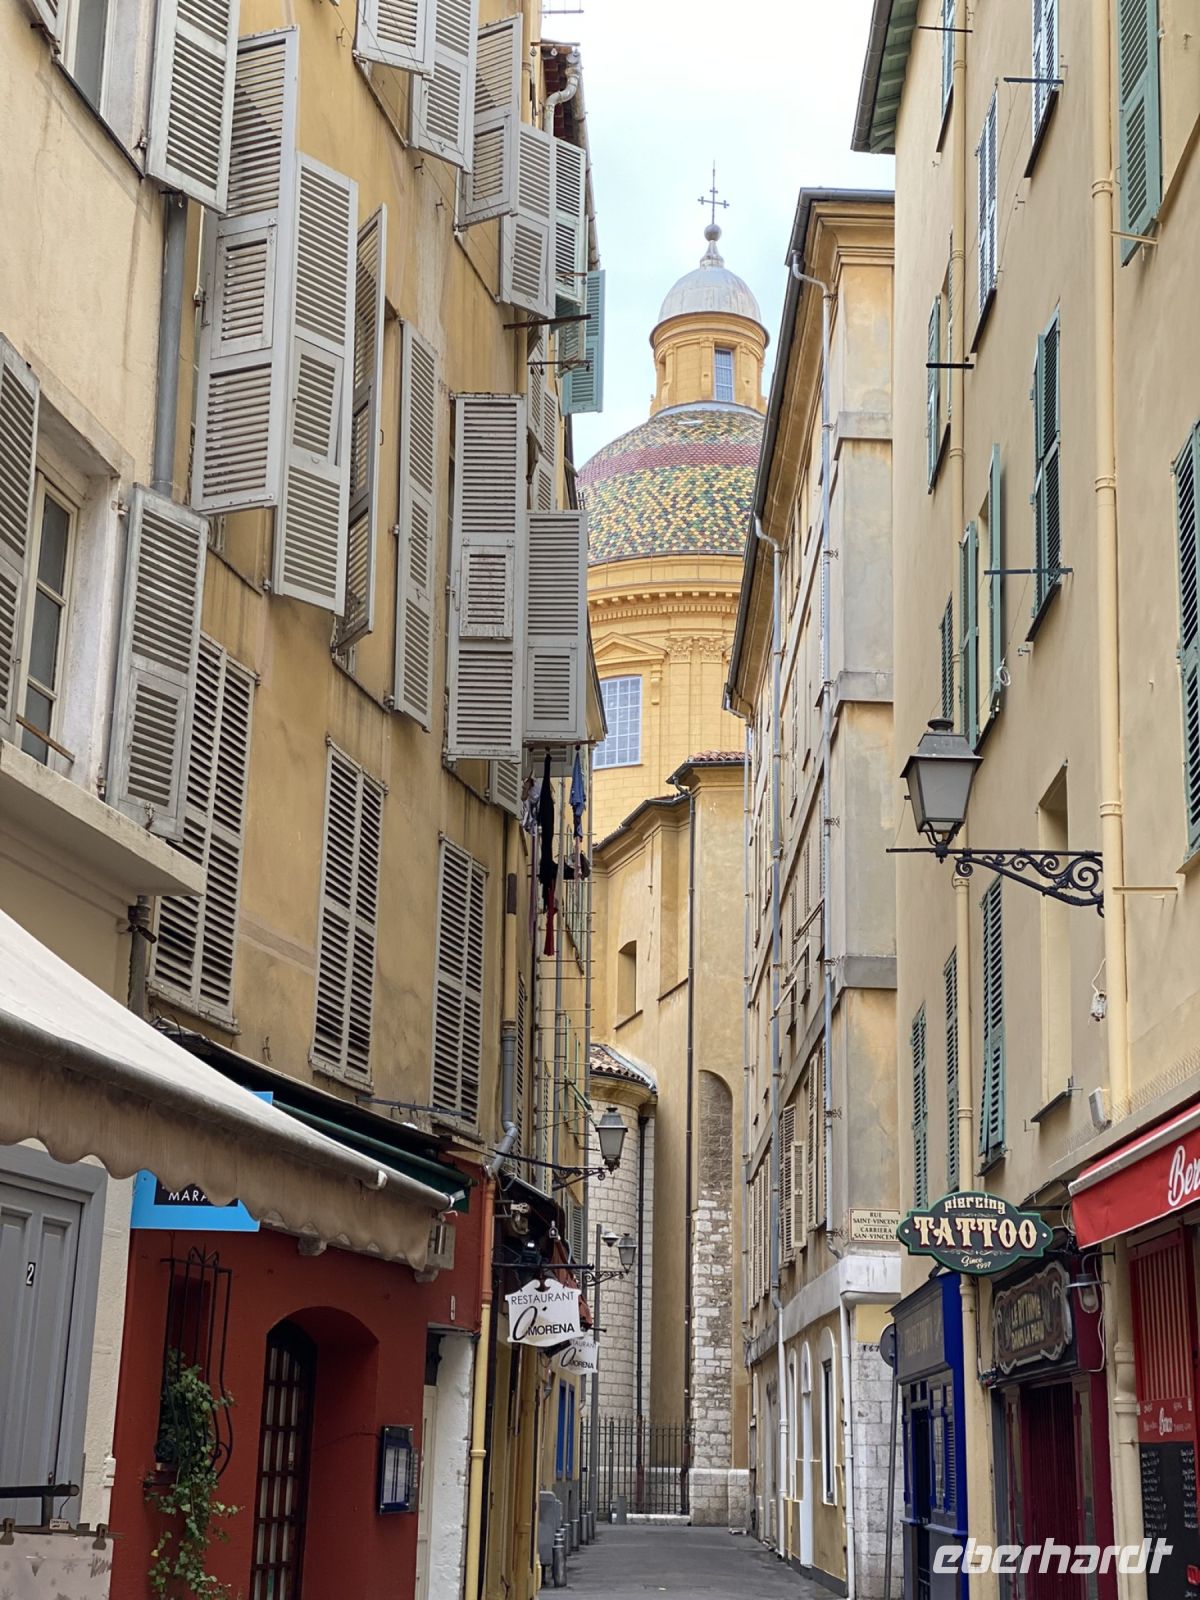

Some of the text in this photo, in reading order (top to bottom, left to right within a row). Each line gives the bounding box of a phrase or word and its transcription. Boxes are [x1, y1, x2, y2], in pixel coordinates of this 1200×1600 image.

[944, 1194, 1006, 1214] piercing
[914, 1216, 1037, 1249] TATTOO
[961, 1255, 983, 1267] Since
[26, 1264, 34, 1284] 2
[511, 1291, 575, 1305] RESTAURANT
